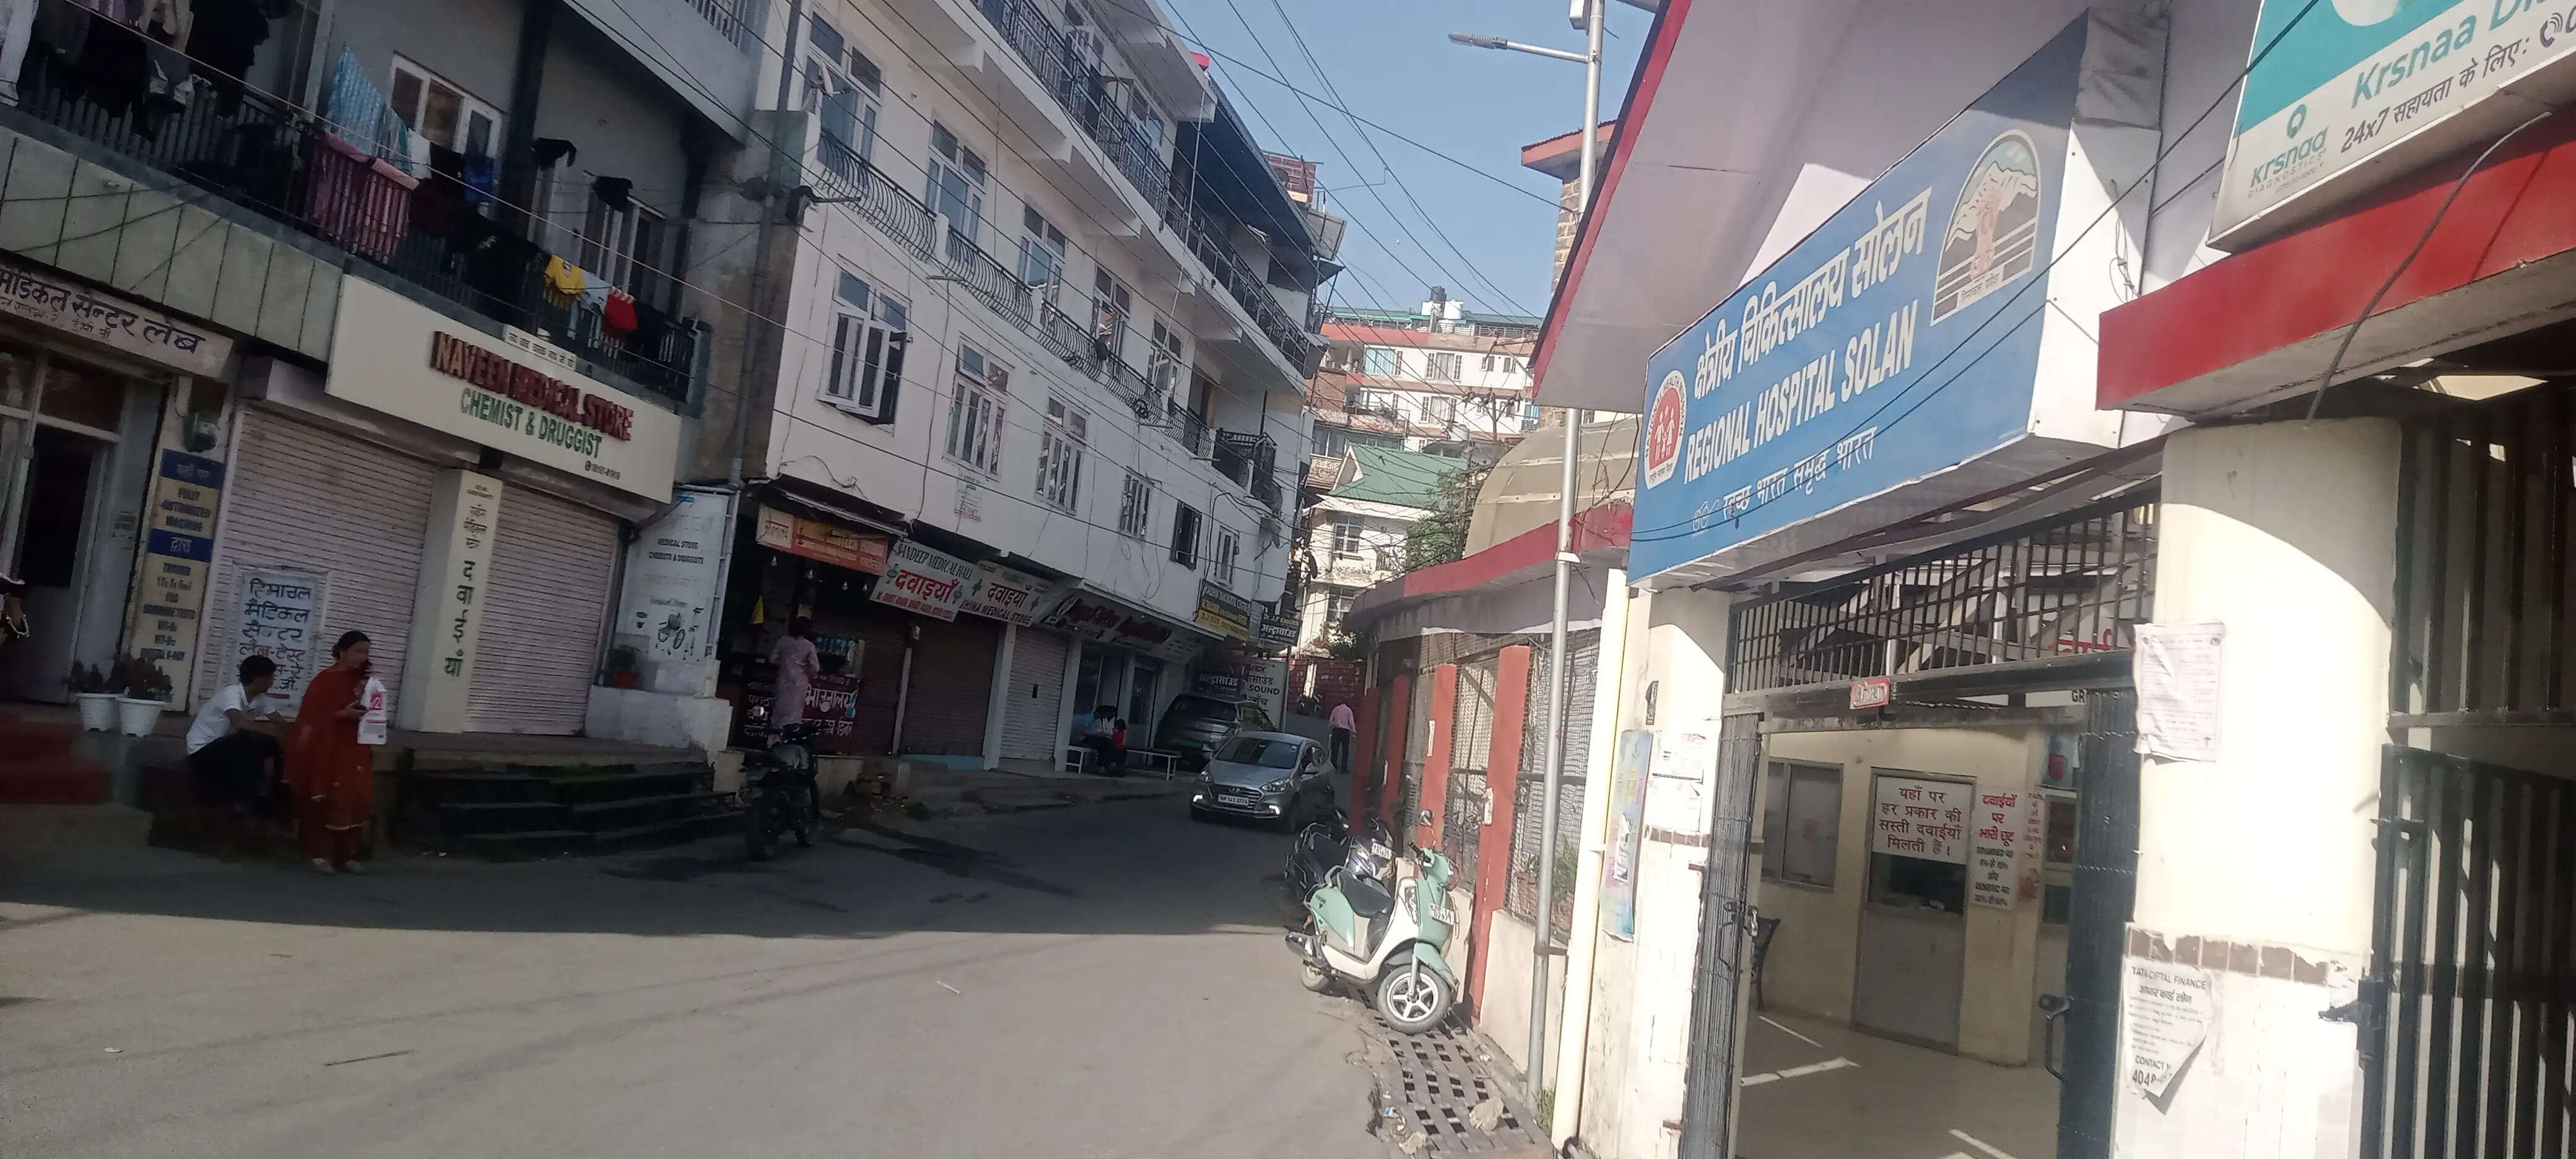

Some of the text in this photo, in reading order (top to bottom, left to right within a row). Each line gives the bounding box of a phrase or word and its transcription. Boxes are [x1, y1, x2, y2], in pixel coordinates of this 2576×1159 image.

[2351, 14, 2476, 109] Krsnaa
[2341, 107, 2391, 154] 24x7
[2393, 76, 2450, 124] सहायता
[2460, 58, 2479, 88] के
[1694, 186, 1932, 400] क्षेत्रीय चिकित्सालय सोलन
[1684, 299, 1918, 484] REGIONAL HOSPITAL SOLAN
[460, 387, 602, 458] CHEMIST & DRUGGIST
[1757, 467, 1788, 505] भारत
[1837, 425, 1878, 471] भारत
[1881, 802, 1962, 823] हर प्रकार की
[1899, 786, 1947, 804] यहाँ पर
[1879, 818, 1910, 833] सस्ती
[1887, 834, 1926, 853] मिलती
[2174, 976, 2206, 989] FINANCE
[2135, 1054, 2166, 1069] CONTACT
